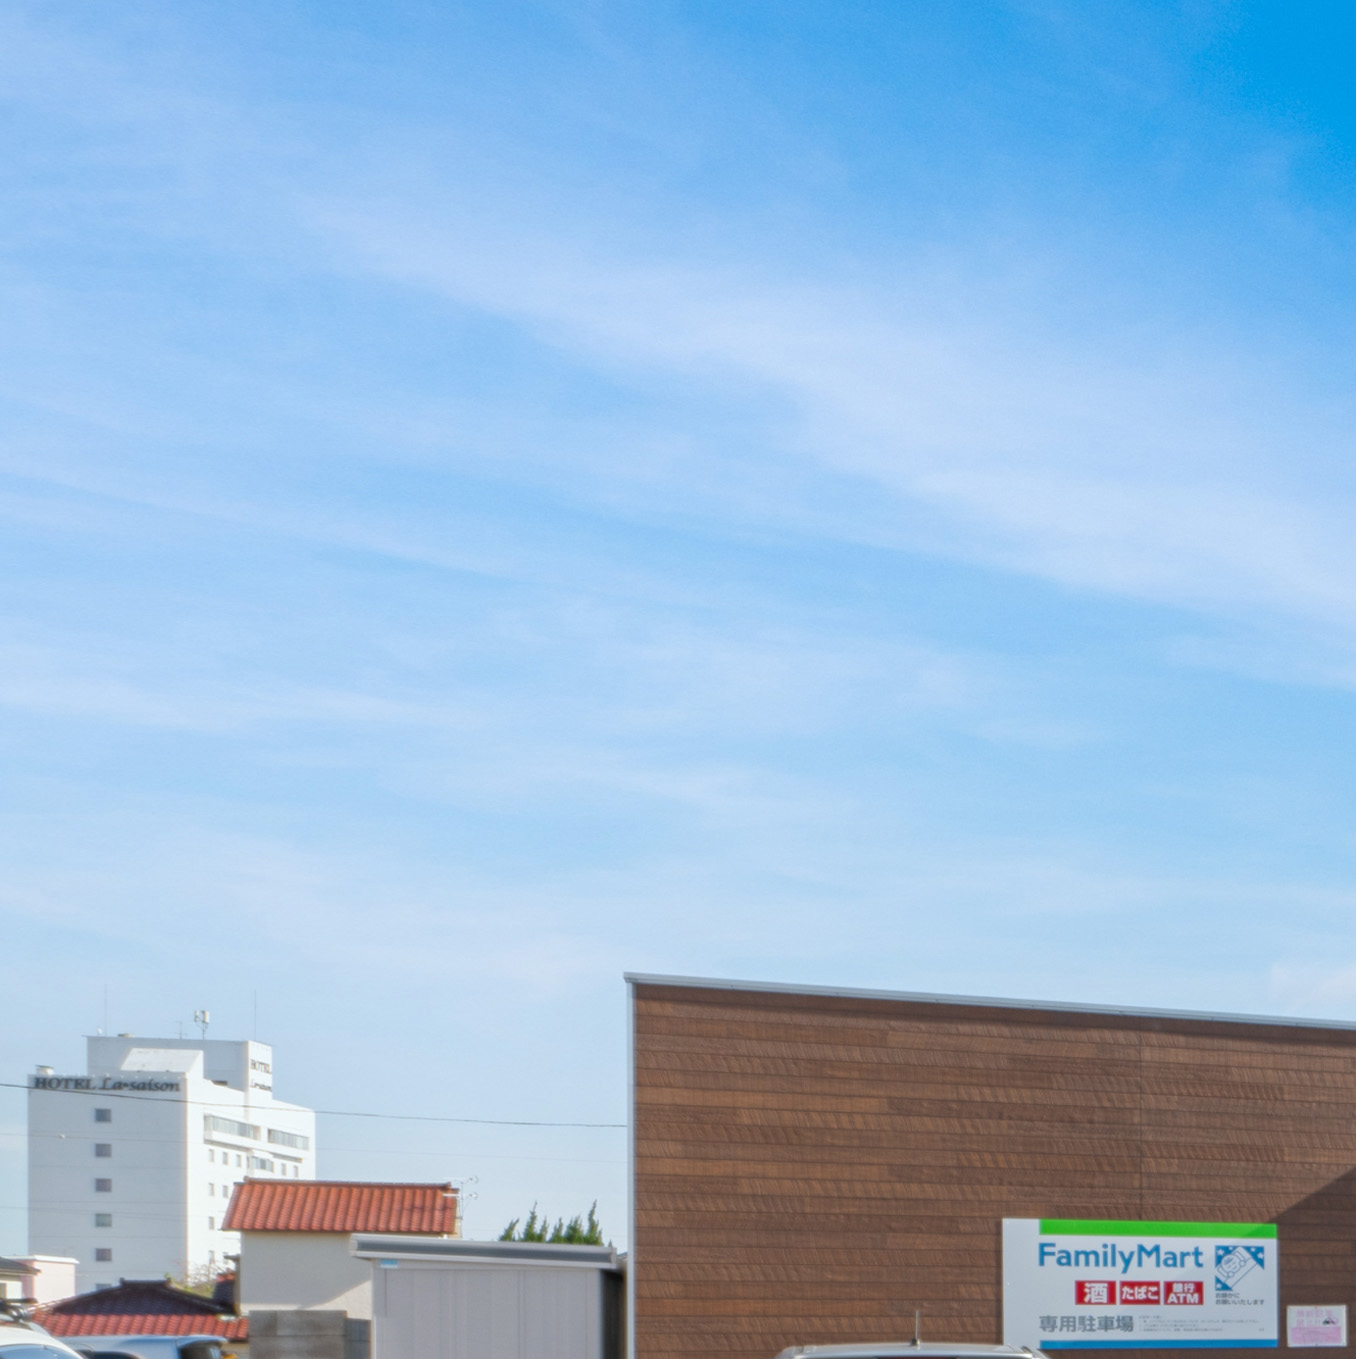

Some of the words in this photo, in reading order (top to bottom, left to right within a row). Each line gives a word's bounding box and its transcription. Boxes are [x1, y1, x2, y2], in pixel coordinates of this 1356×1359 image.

[34, 1077, 96, 1091] HOTEL
[1038, 1242, 1204, 1274] FamilyMart
[1084, 1282, 1108, 1304] 酒
[1121, 1285, 1159, 1300] たばこ
[1172, 1283, 1194, 1293] 銀行
[1167, 1293, 1199, 1304] ATM
[1039, 1314, 1134, 1333] 専用駐車場
